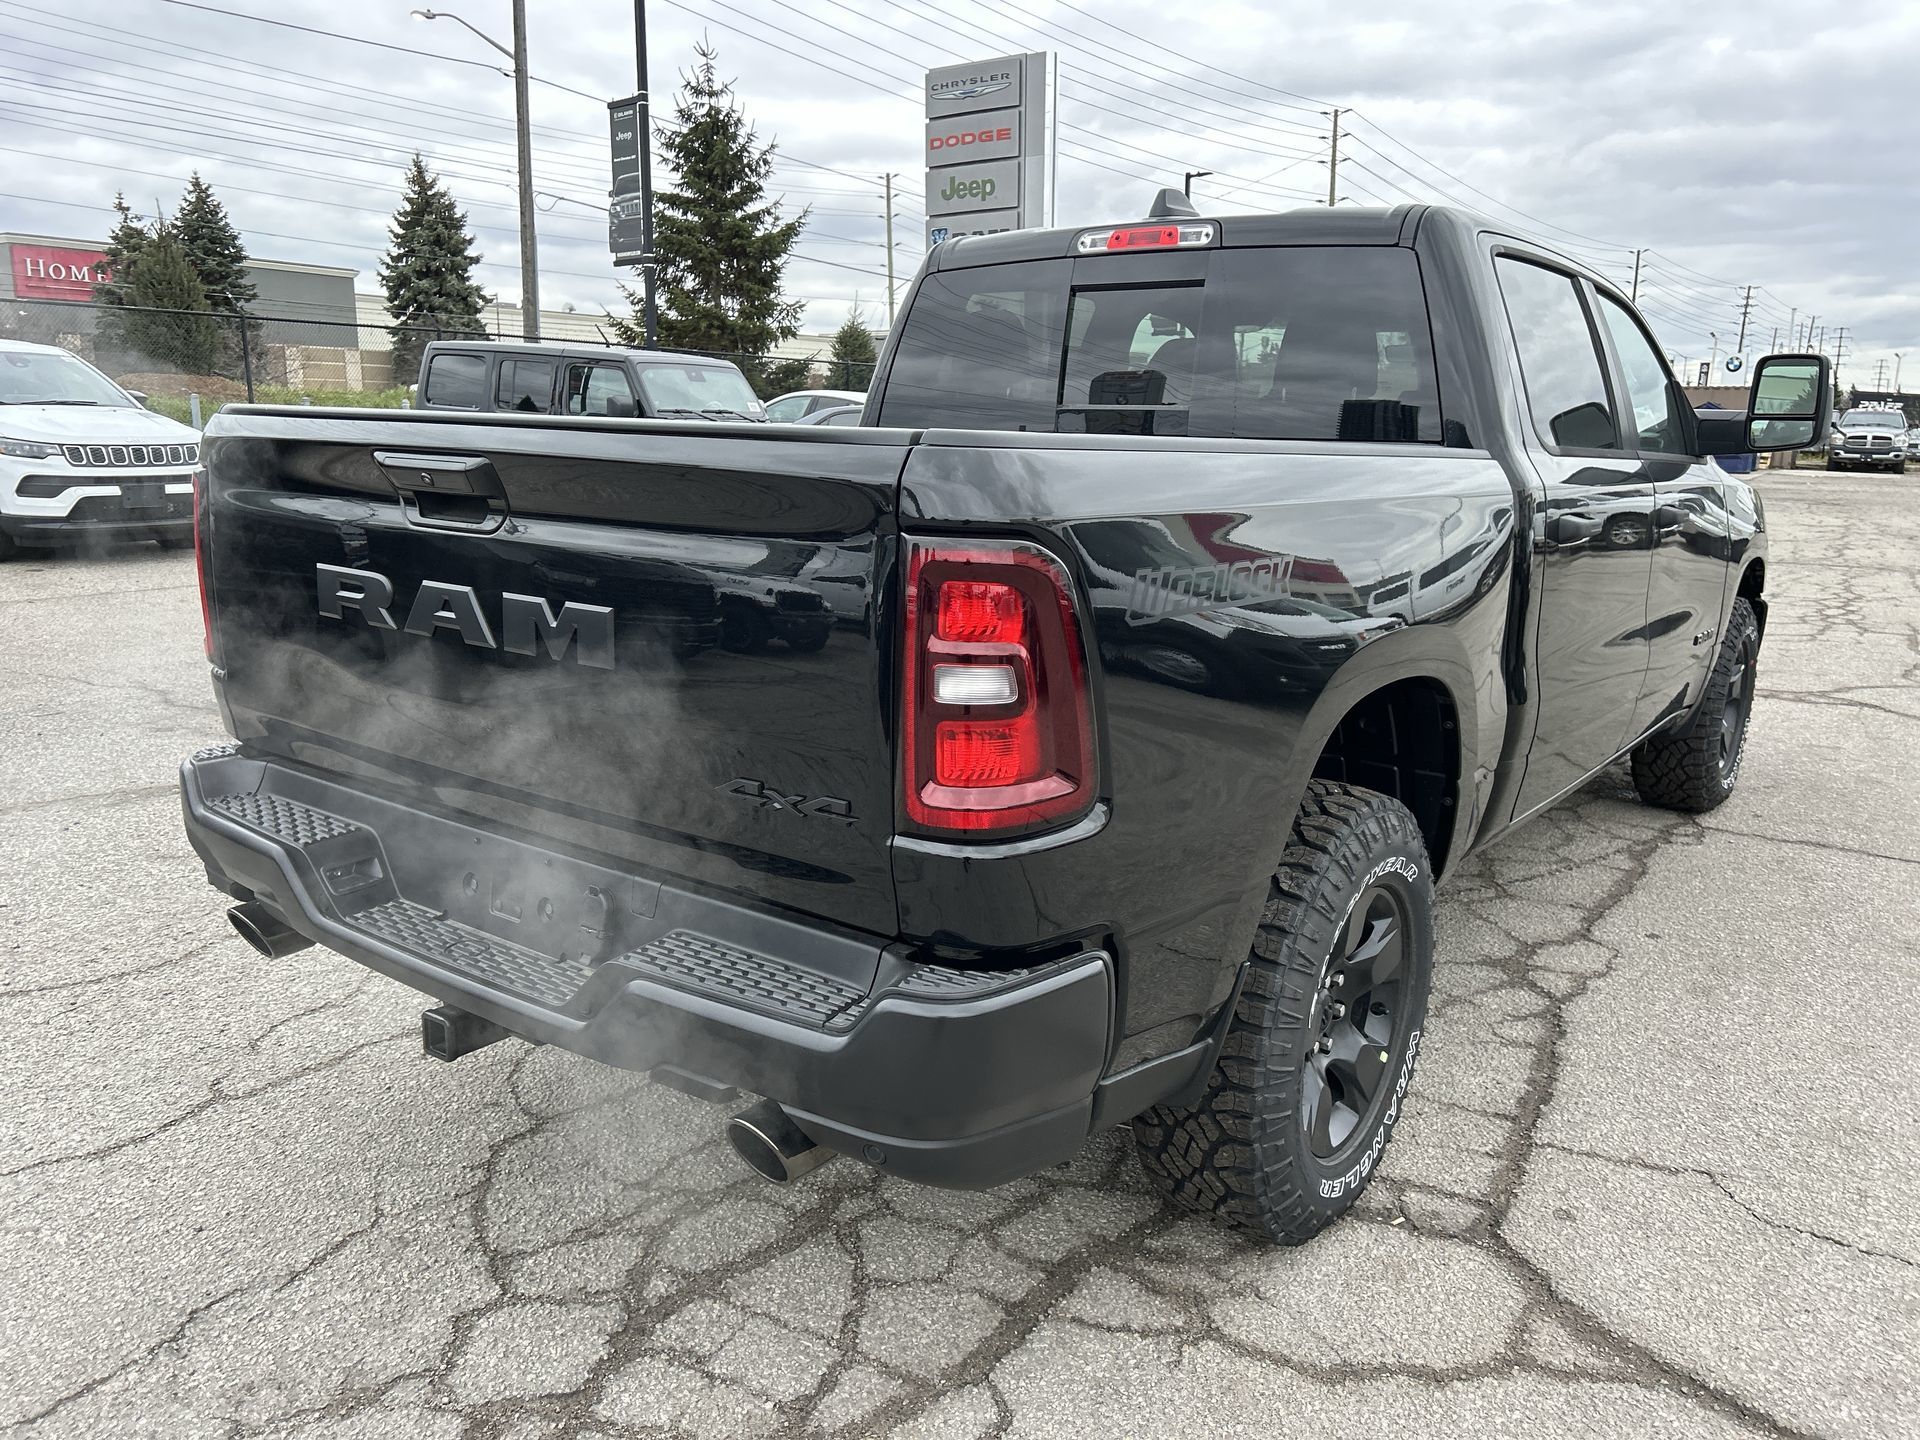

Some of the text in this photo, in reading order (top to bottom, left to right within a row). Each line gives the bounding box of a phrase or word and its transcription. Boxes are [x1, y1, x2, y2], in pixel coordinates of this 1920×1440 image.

[931, 72, 1011, 91] CHRYSLER
[615, 131, 632, 141] Jeep
[929, 128, 1012, 150] DODGE
[940, 176, 996, 201] Jeep
[317, 562, 615, 670] RAM
[1320, 1030, 1420, 1199] WRANGLER
